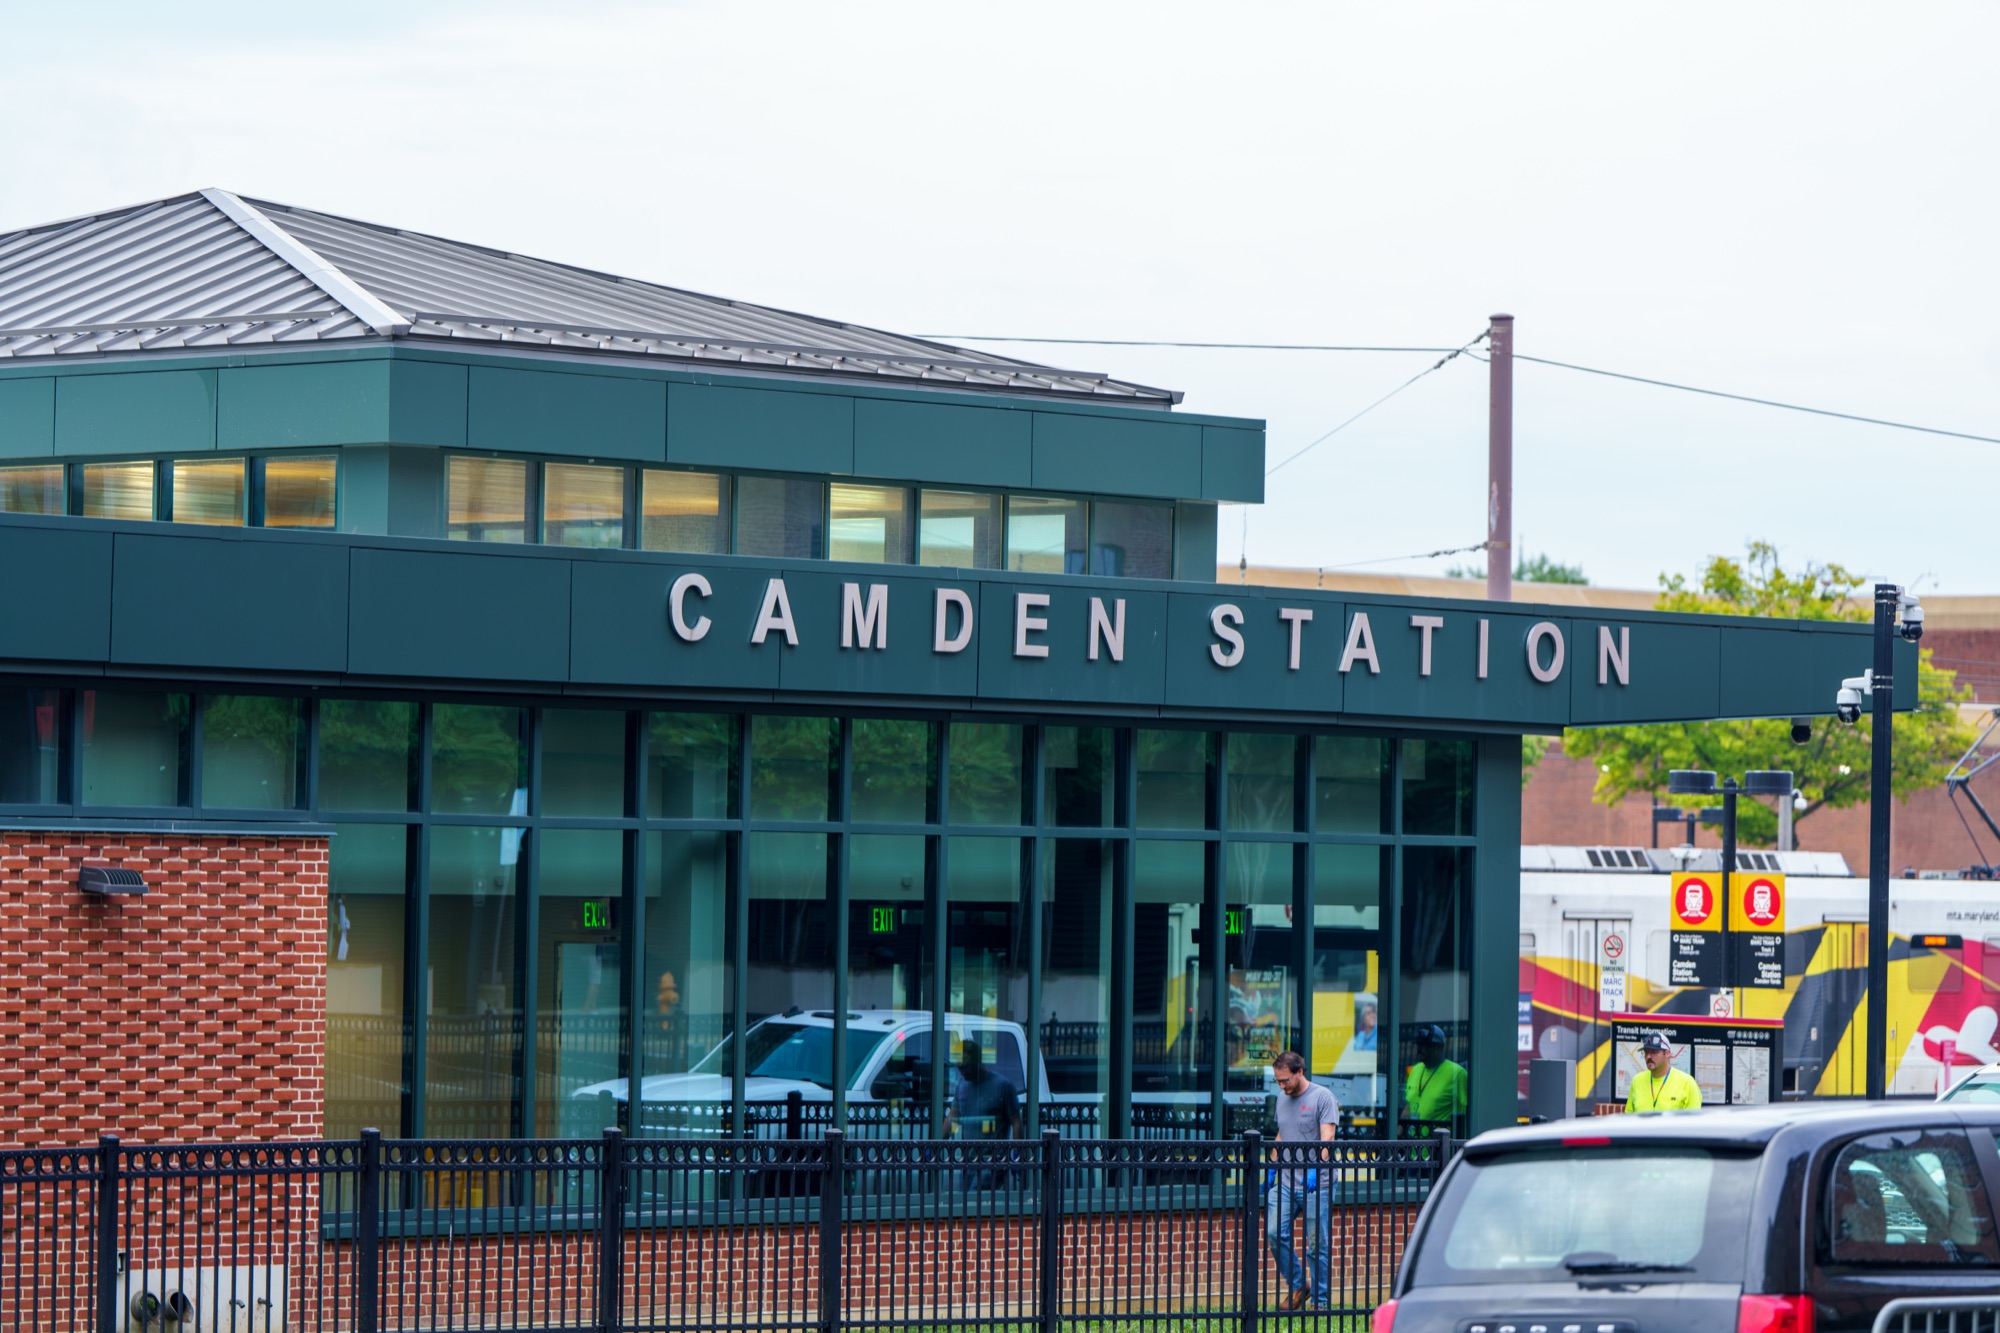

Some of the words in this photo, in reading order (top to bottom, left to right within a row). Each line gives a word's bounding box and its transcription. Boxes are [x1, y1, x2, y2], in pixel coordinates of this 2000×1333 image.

[669, 572, 1126, 662] CAMDEN
[1208, 603, 1630, 686] STATION
[873, 907, 895, 932] EXIT
[1672, 960, 1697, 969] Camden
[1757, 961, 1782, 971] Camden
[1672, 968, 1693, 977] Station
[1761, 970, 1782, 979] Station
[1603, 978, 1623, 986] MARC
[1602, 988, 1624, 997] TRACK
[1610, 999, 1615, 1009] 3
[1616, 1025, 1639, 1035] Transit
[1640, 1027, 1677, 1037] Information
